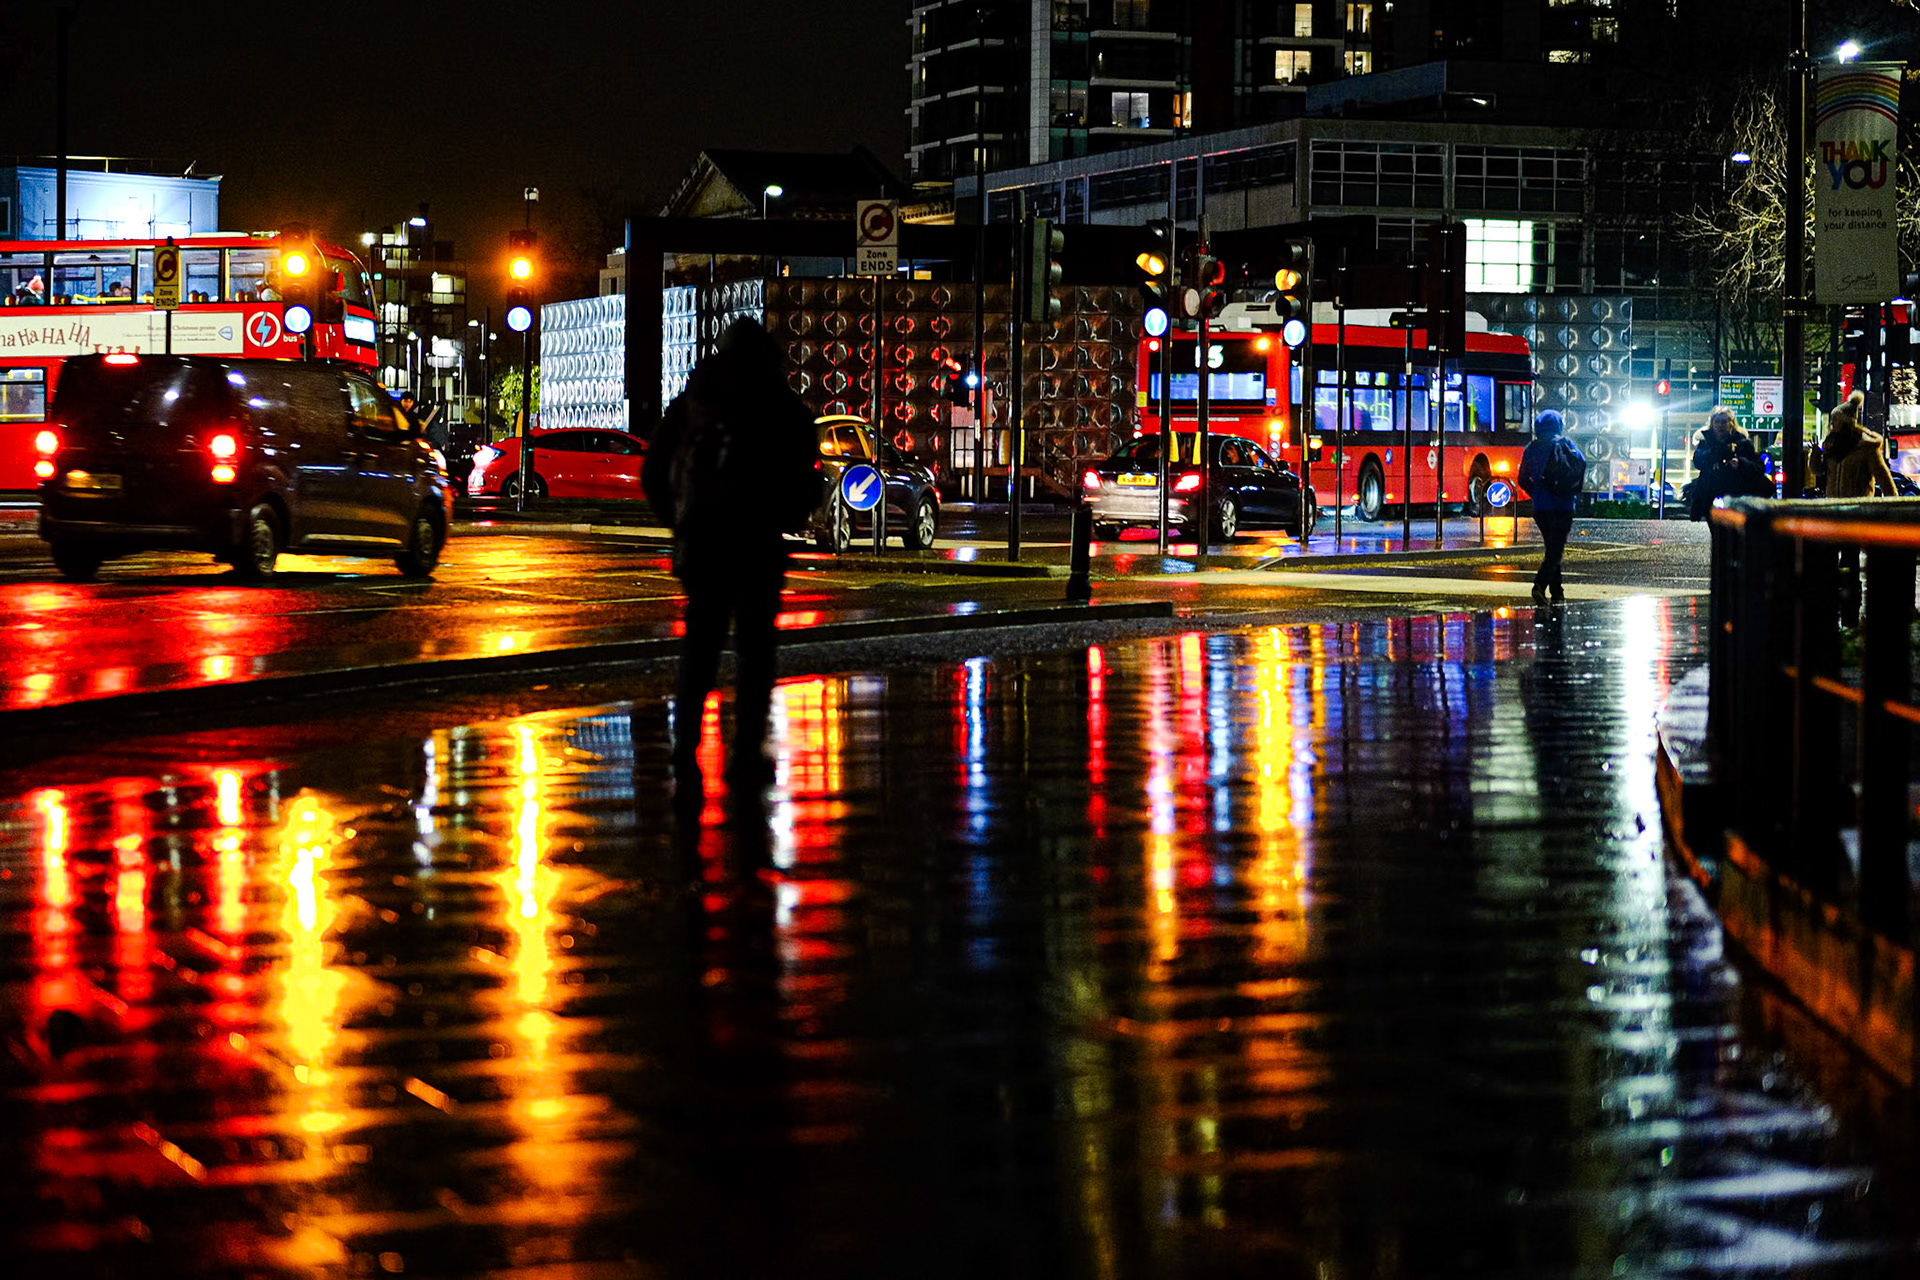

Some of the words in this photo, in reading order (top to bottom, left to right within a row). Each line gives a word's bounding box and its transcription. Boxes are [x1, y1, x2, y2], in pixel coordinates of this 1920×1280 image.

[1819, 139, 1891, 163] THANK
[1827, 159, 1888, 190] YOU
[1828, 207, 1842, 218] for
[1844, 207, 1882, 220] keeping
[1823, 220, 1846, 232] your
[1848, 219, 1887, 230] distance
[866, 250, 888, 259] Zone
[861, 260, 894, 272] ENDS
[159, 288, 174, 296] Zone
[156, 297, 177, 307] ENDS
[283, 334, 298, 342] bus
